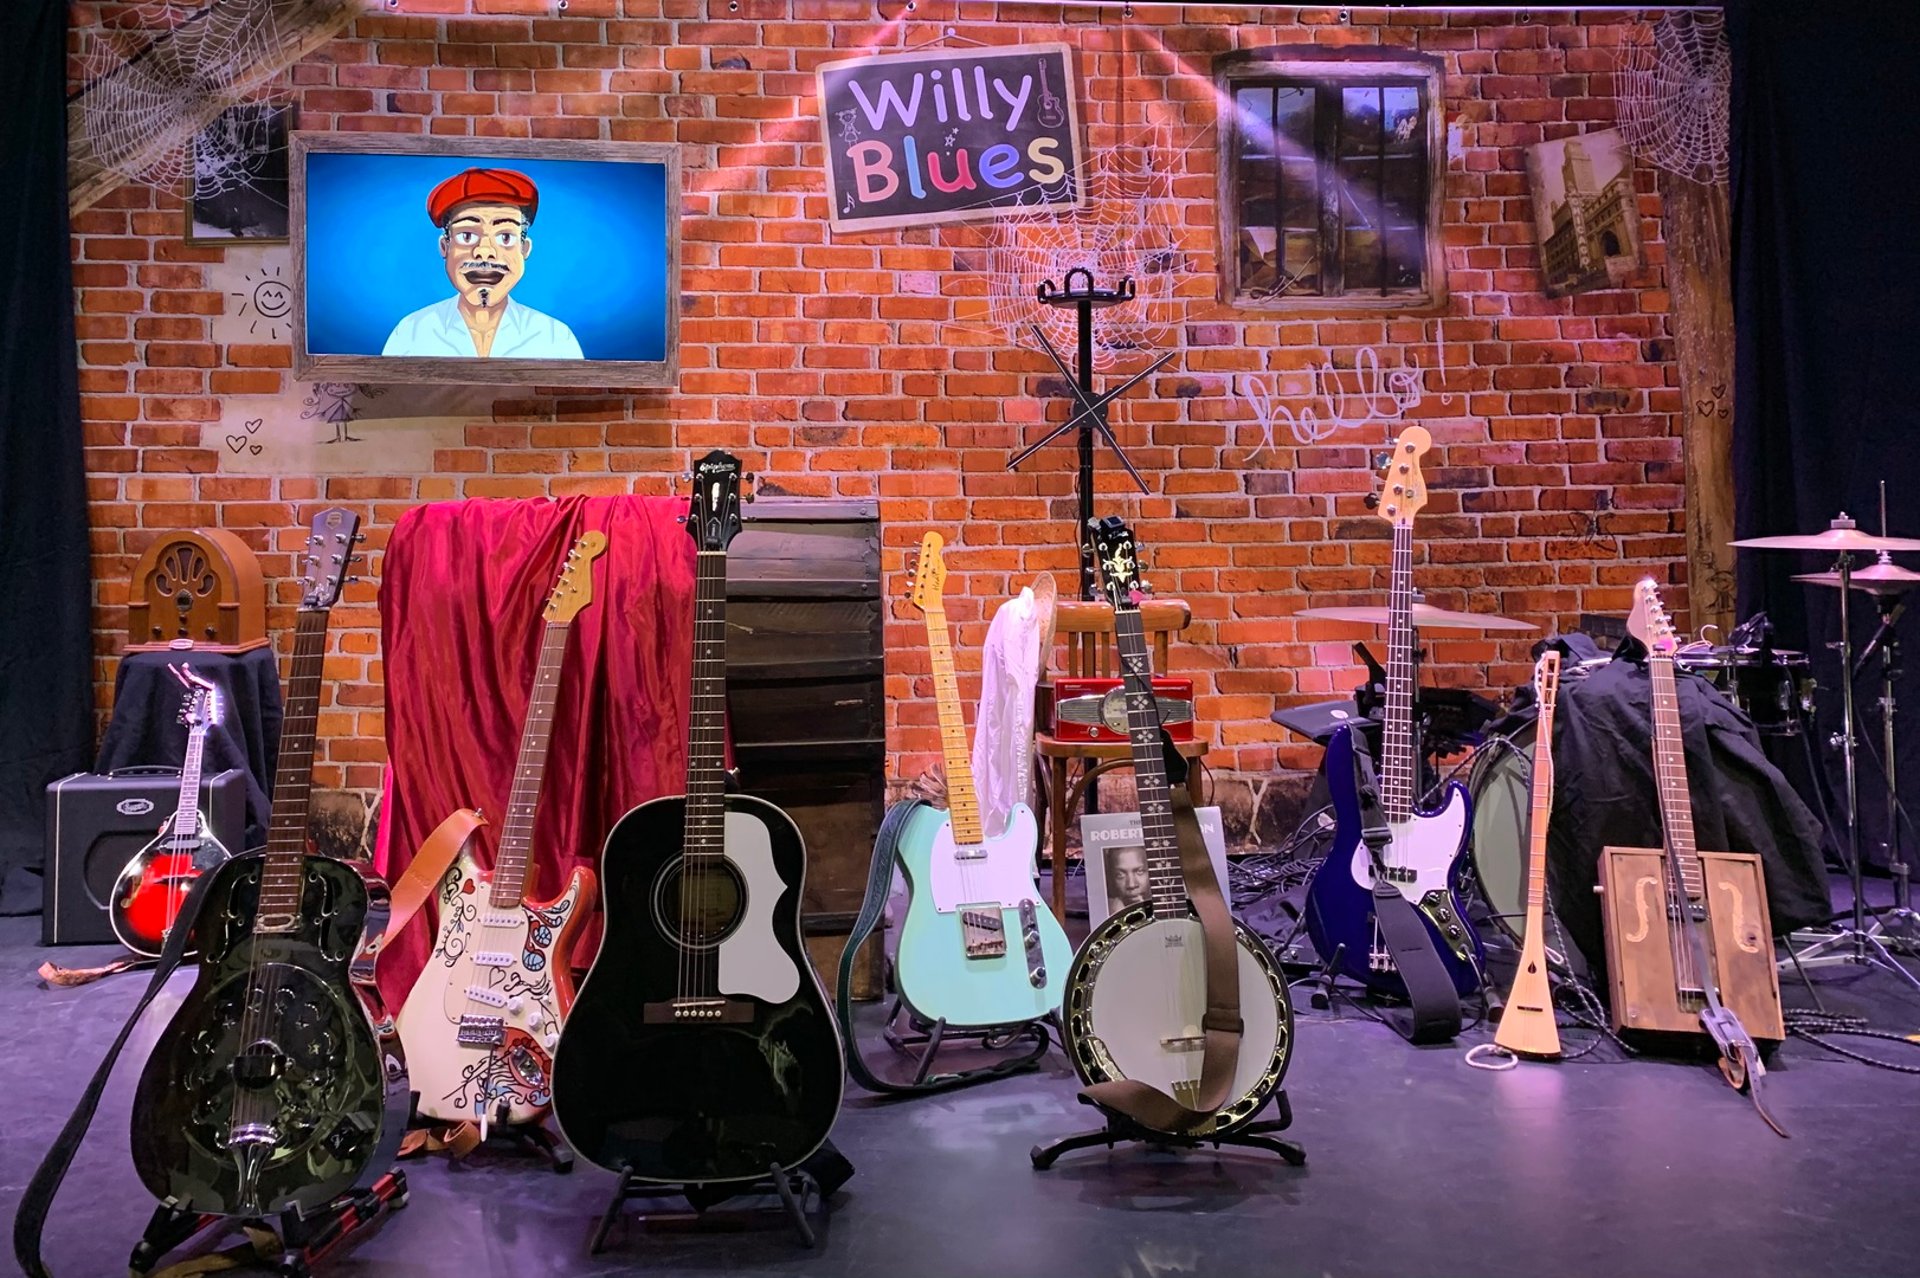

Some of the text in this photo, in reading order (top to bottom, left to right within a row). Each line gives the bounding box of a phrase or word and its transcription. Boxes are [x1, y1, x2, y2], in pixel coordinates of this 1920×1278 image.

[848, 65, 1033, 132] Willy
[846, 135, 1065, 203] Blues
[1090, 827, 1143, 841] ROBERT
